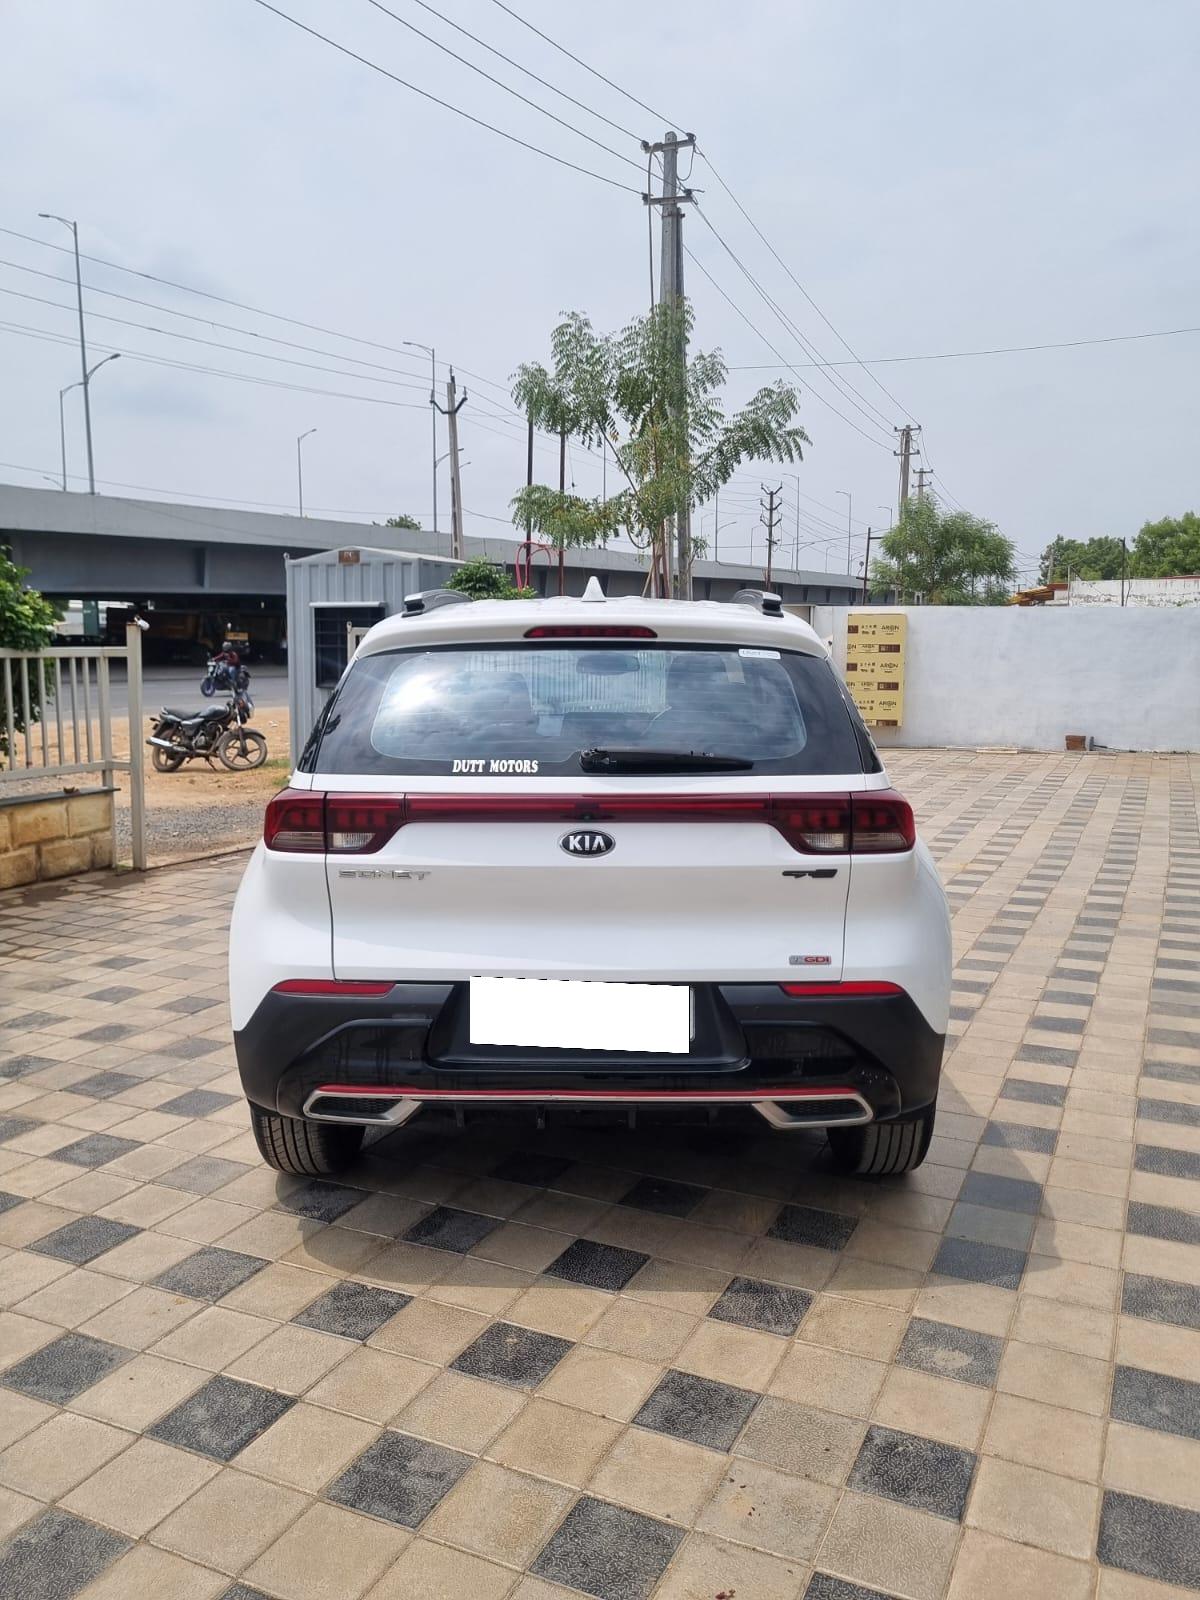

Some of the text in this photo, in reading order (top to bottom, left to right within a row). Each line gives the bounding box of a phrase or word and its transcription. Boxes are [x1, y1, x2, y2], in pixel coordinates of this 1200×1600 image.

[452, 759, 539, 774] DUTT MOTORS
[568, 835, 607, 851] KIA
